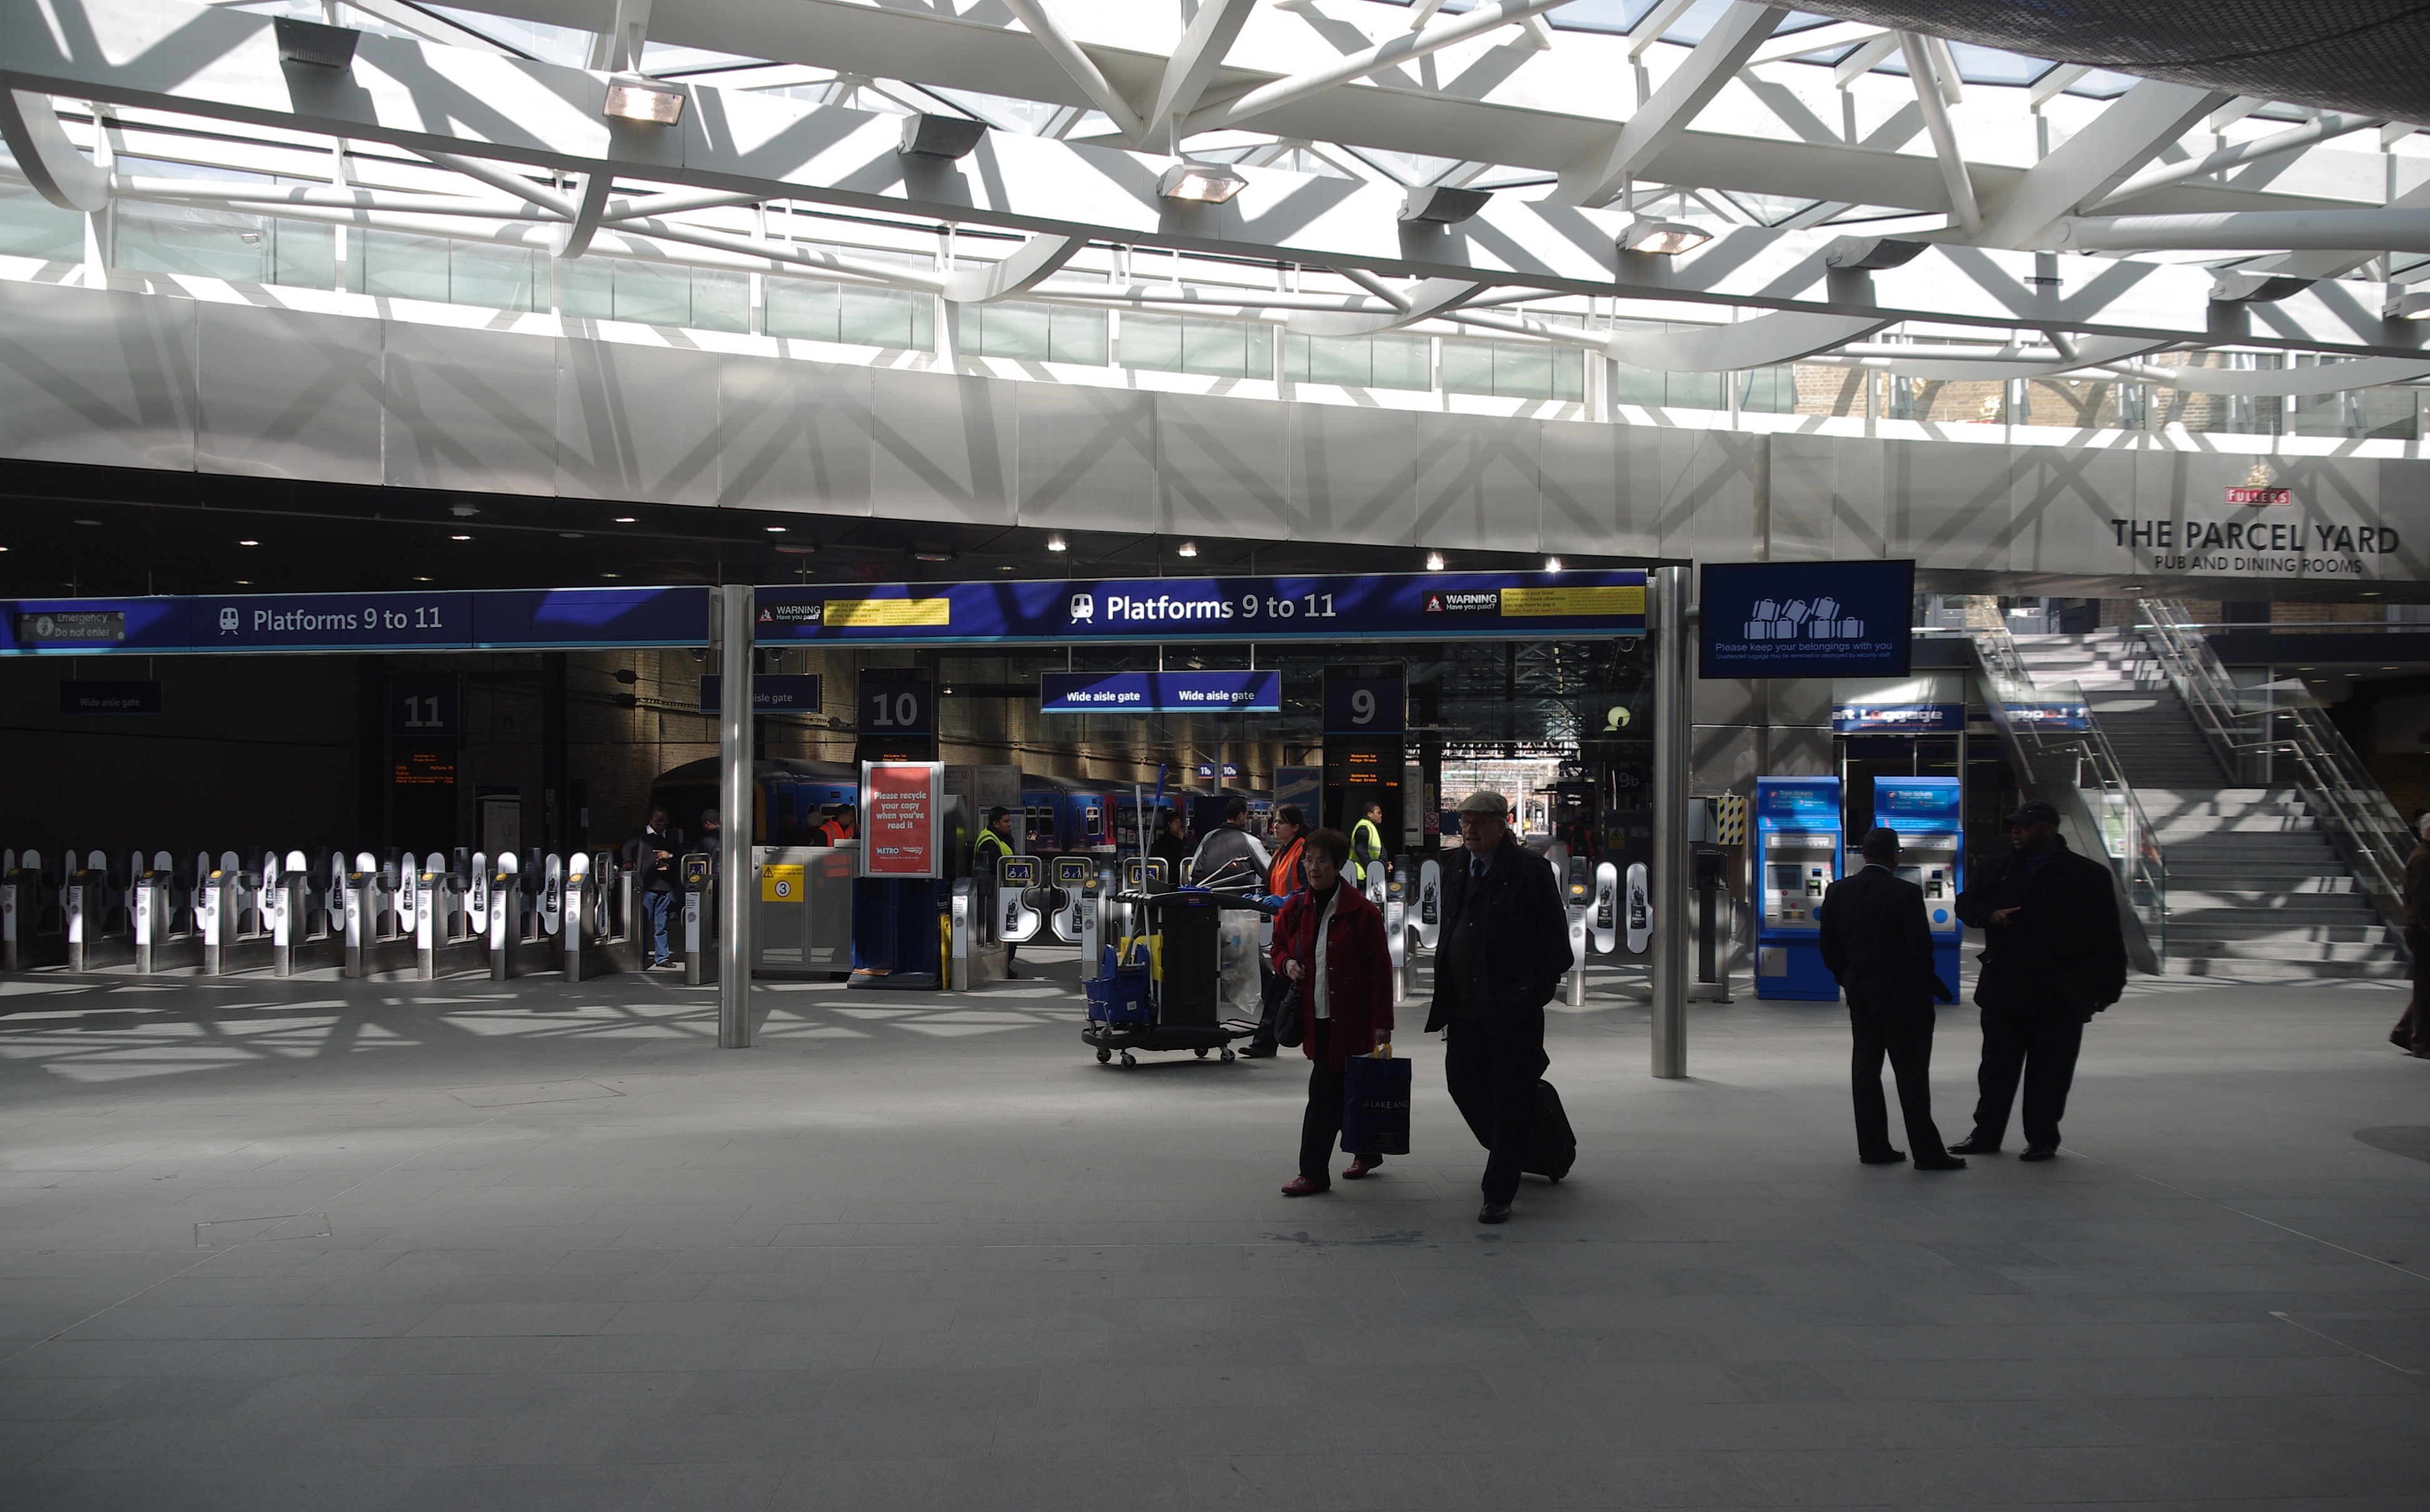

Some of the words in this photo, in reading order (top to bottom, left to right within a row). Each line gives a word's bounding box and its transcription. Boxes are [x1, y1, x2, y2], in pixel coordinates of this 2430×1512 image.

[2228, 490, 2287, 503] FULLER'S
[2111, 519, 2172, 548] THE
[2186, 522, 2305, 552] PARCEL
[2314, 525, 2400, 555] YARD
[2155, 556, 2186, 570] PUB
[2190, 557, 2228, 571] AND
[2235, 558, 2297, 572] DINING
[2303, 560, 2362, 573] ROOMS
[1445, 594, 1497, 604] WARNING
[776, 605, 821, 614] WARNING
[1107, 595, 1234, 620] Platforms
[1242, 593, 1258, 618] 9
[1265, 598, 1295, 618] to
[1304, 593, 1337, 618] 11
[57, 613, 108, 625] Emergency
[254, 609, 358, 631] Platforms
[363, 608, 377, 630] 9
[383, 611, 408, 629] to
[415, 607, 443, 628] 11
[55, 628, 68, 637] Do
[69, 628, 85, 637] not
[87, 627, 110, 637] enter
[1750, 643, 1773, 652] keep
[1776, 644, 1796, 652] your
[1799, 643, 1850, 652] belongings
[1853, 642, 1872, 650] with
[1875, 643, 1892, 651] you
[754, 693, 770, 702] isle
[772, 694, 793, 704] gate
[1066, 691, 1091, 702] Wide
[1094, 690, 1116, 702] aisle
[1118, 692, 1141, 703] gate
[1178, 690, 1204, 701] Wide
[1206, 690, 1229, 700] aisle
[1232, 692, 1255, 703] gate
[80, 698, 99, 707] Wide
[102, 698, 120, 706] aisle
[122, 699, 141, 708] gate
[1352, 689, 1375, 724] 9
[405, 696, 443, 727] 11
[873, 692, 917, 726] 10
[1833, 709, 1855, 720] eft
[1860, 708, 1943, 723] Luggage
[1200, 767, 1212, 775] 11b
[1223, 767, 1237, 775] 10b
[1619, 772, 1639, 788] 9b
[874, 792, 898, 800] Please
[900, 791, 926, 801] recycle
[881, 803, 899, 811] your
[901, 803, 919, 811] copy
[899, 811, 924, 820] you've
[888, 821, 905, 829] read
[908, 821, 913, 829] it
[779, 883, 786, 894] 3
[1370, 1101, 1409, 1109] LAKEAND
